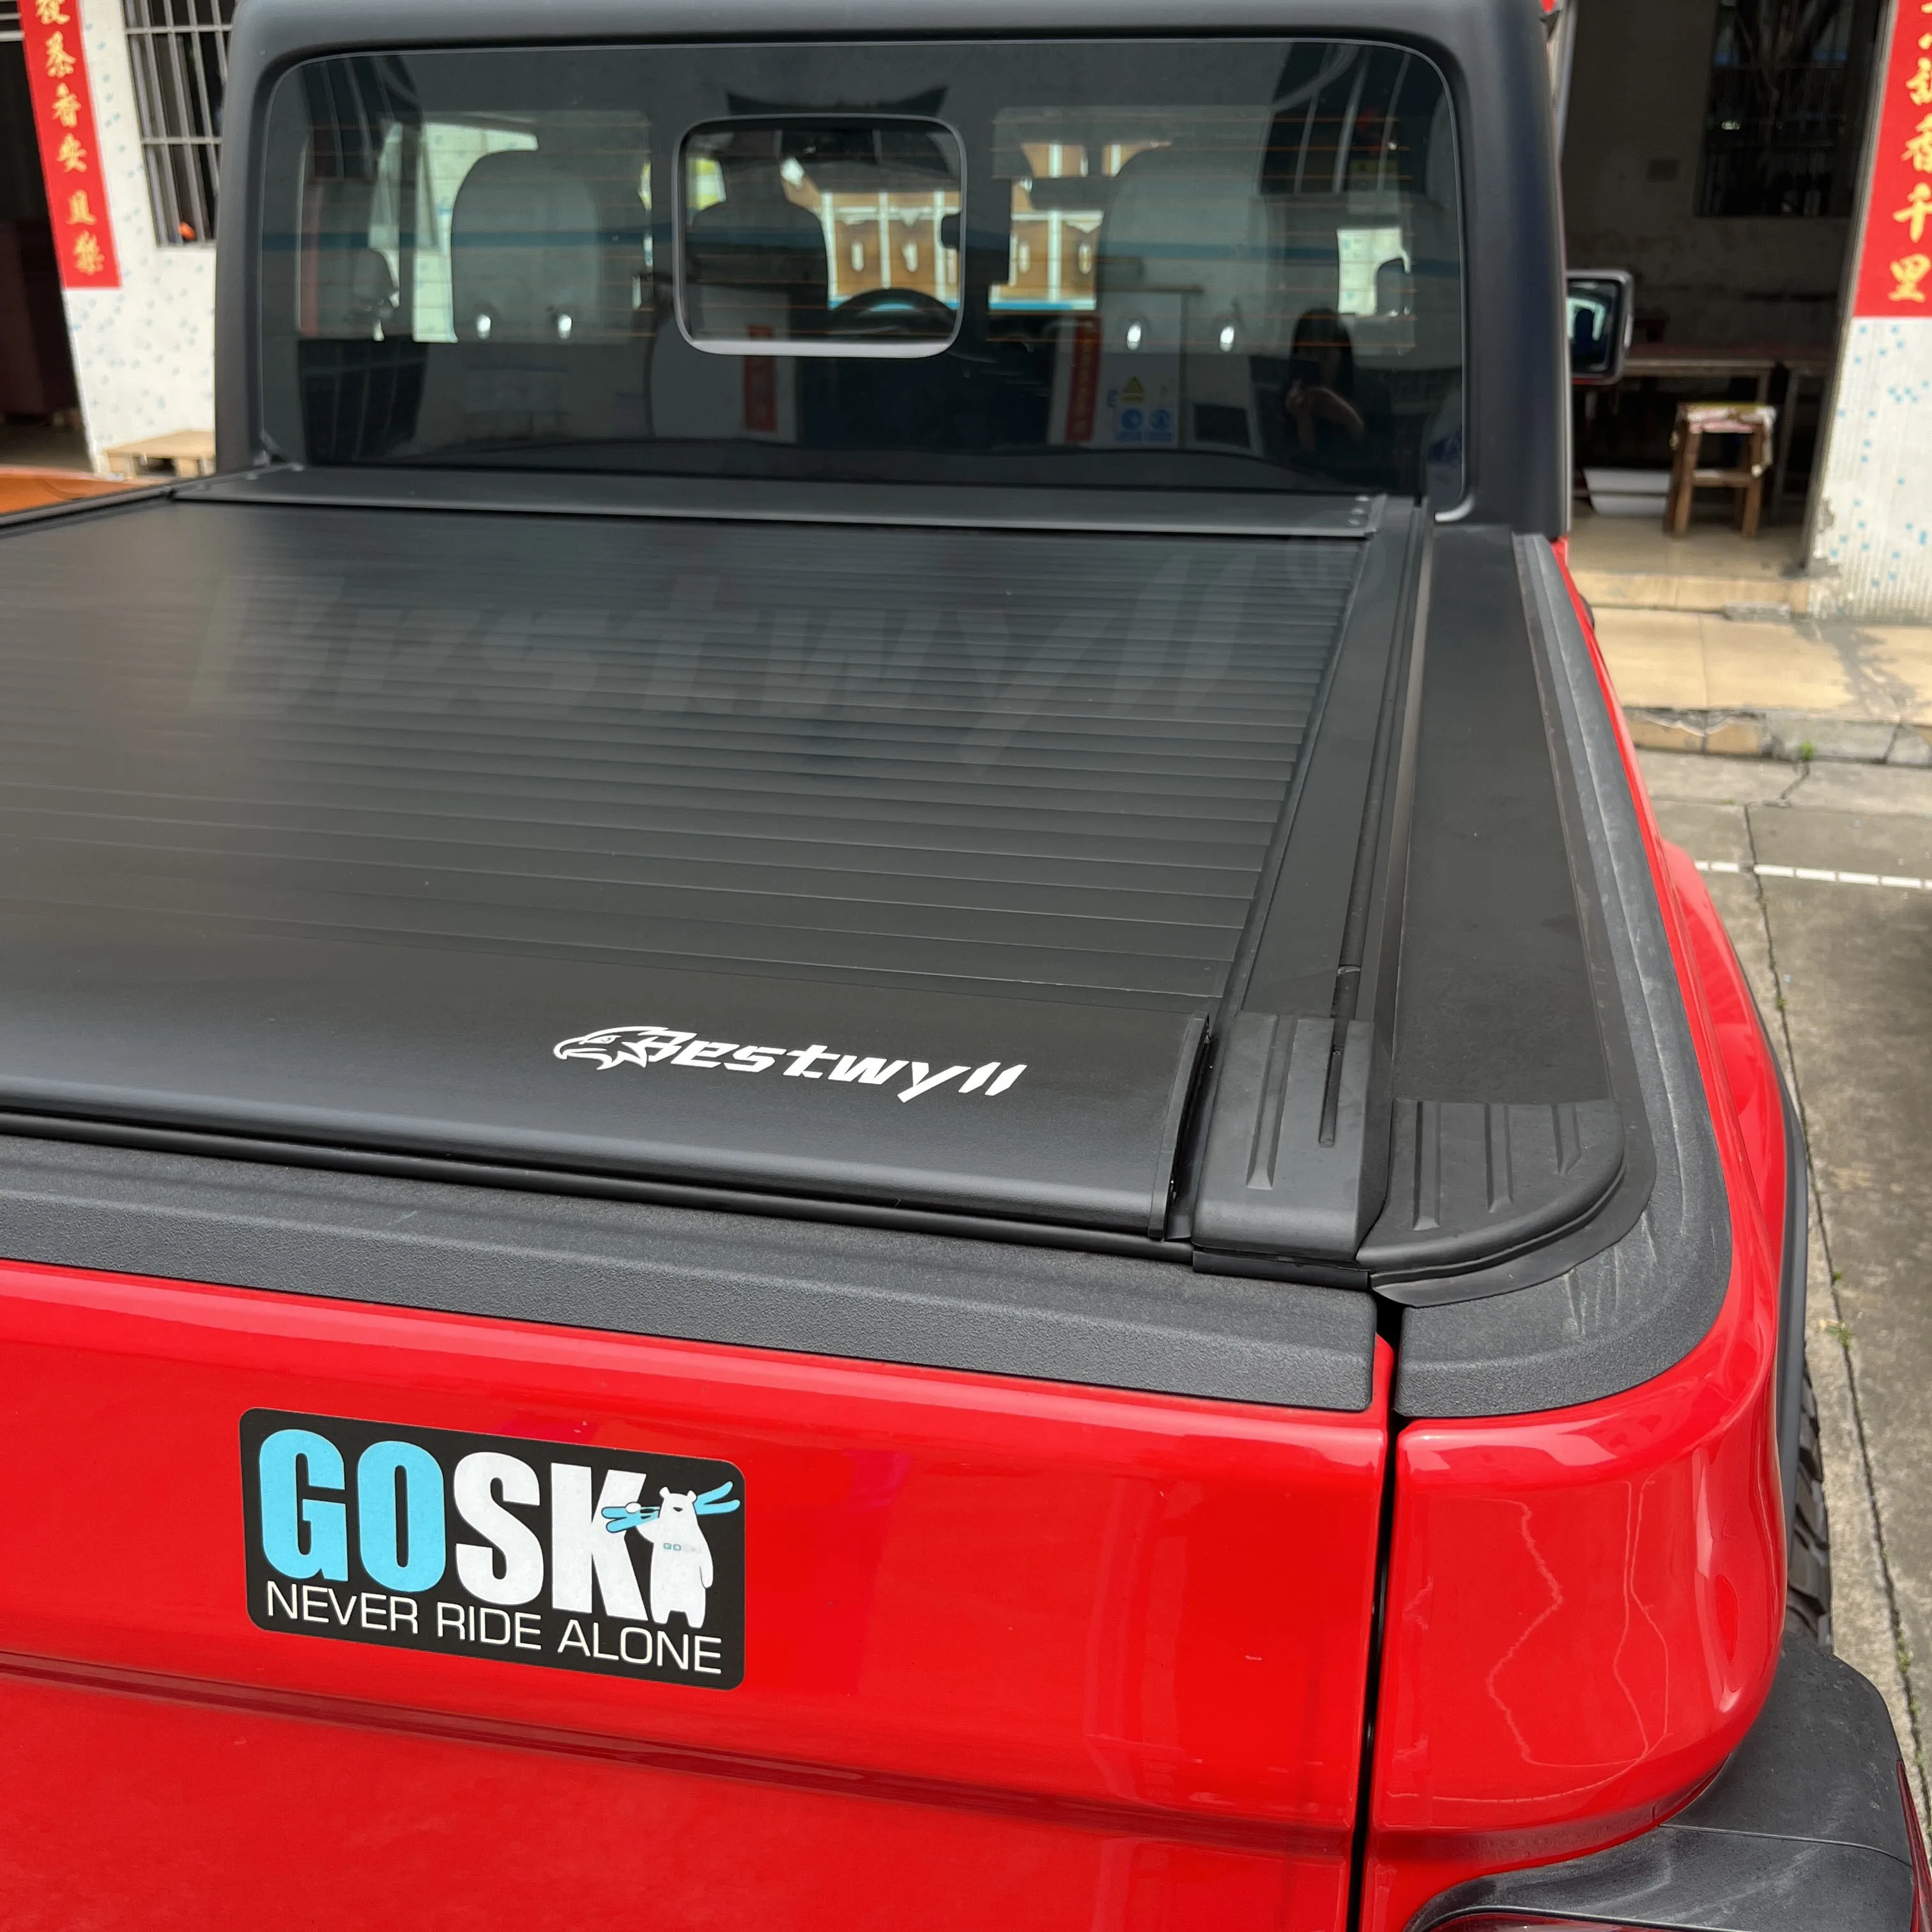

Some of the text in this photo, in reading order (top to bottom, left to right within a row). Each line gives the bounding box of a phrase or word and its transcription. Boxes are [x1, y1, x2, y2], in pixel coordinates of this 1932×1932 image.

[622, 1027, 1027, 1103] Bestwyll
[266, 1580, 723, 1675] NEVER RIDE ALONE
